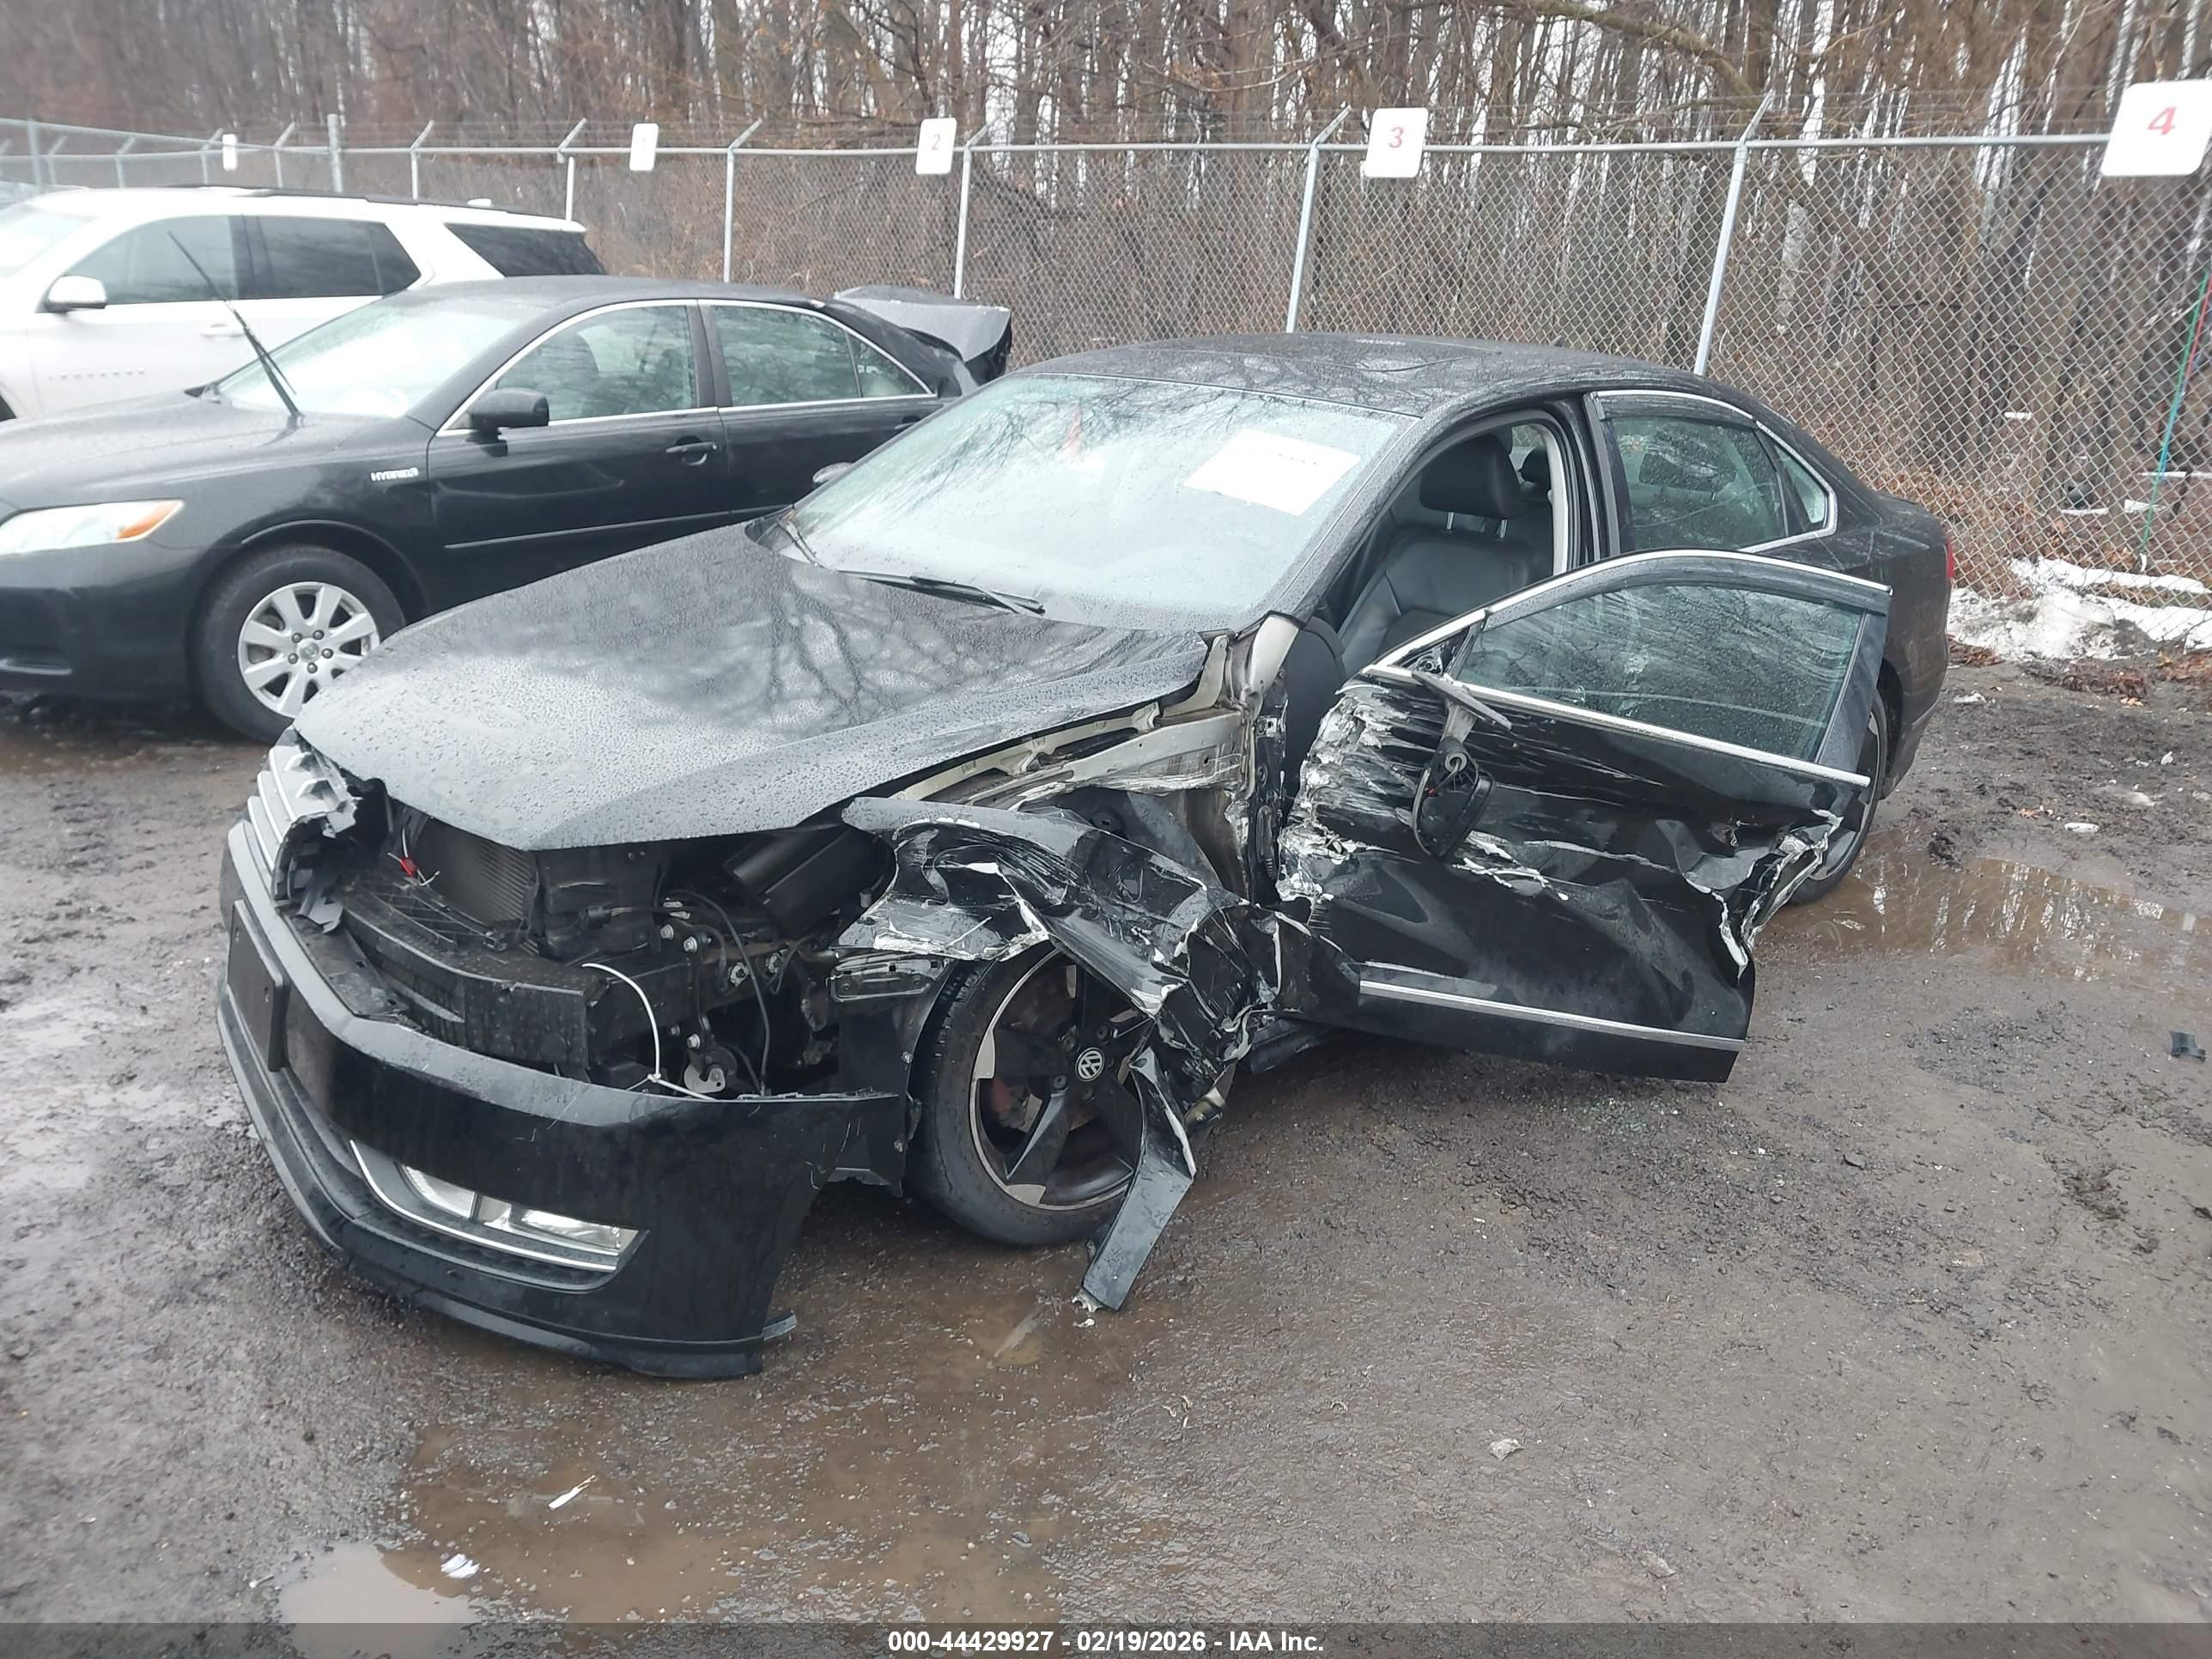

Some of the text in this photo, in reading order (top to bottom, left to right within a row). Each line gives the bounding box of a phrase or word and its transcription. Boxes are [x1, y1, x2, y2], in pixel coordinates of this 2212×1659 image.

[2148, 106, 2177, 136] 4
[931, 132, 941, 151] 2
[1388, 126, 1405, 149] 3
[1076, 1048, 1104, 1081] VW
